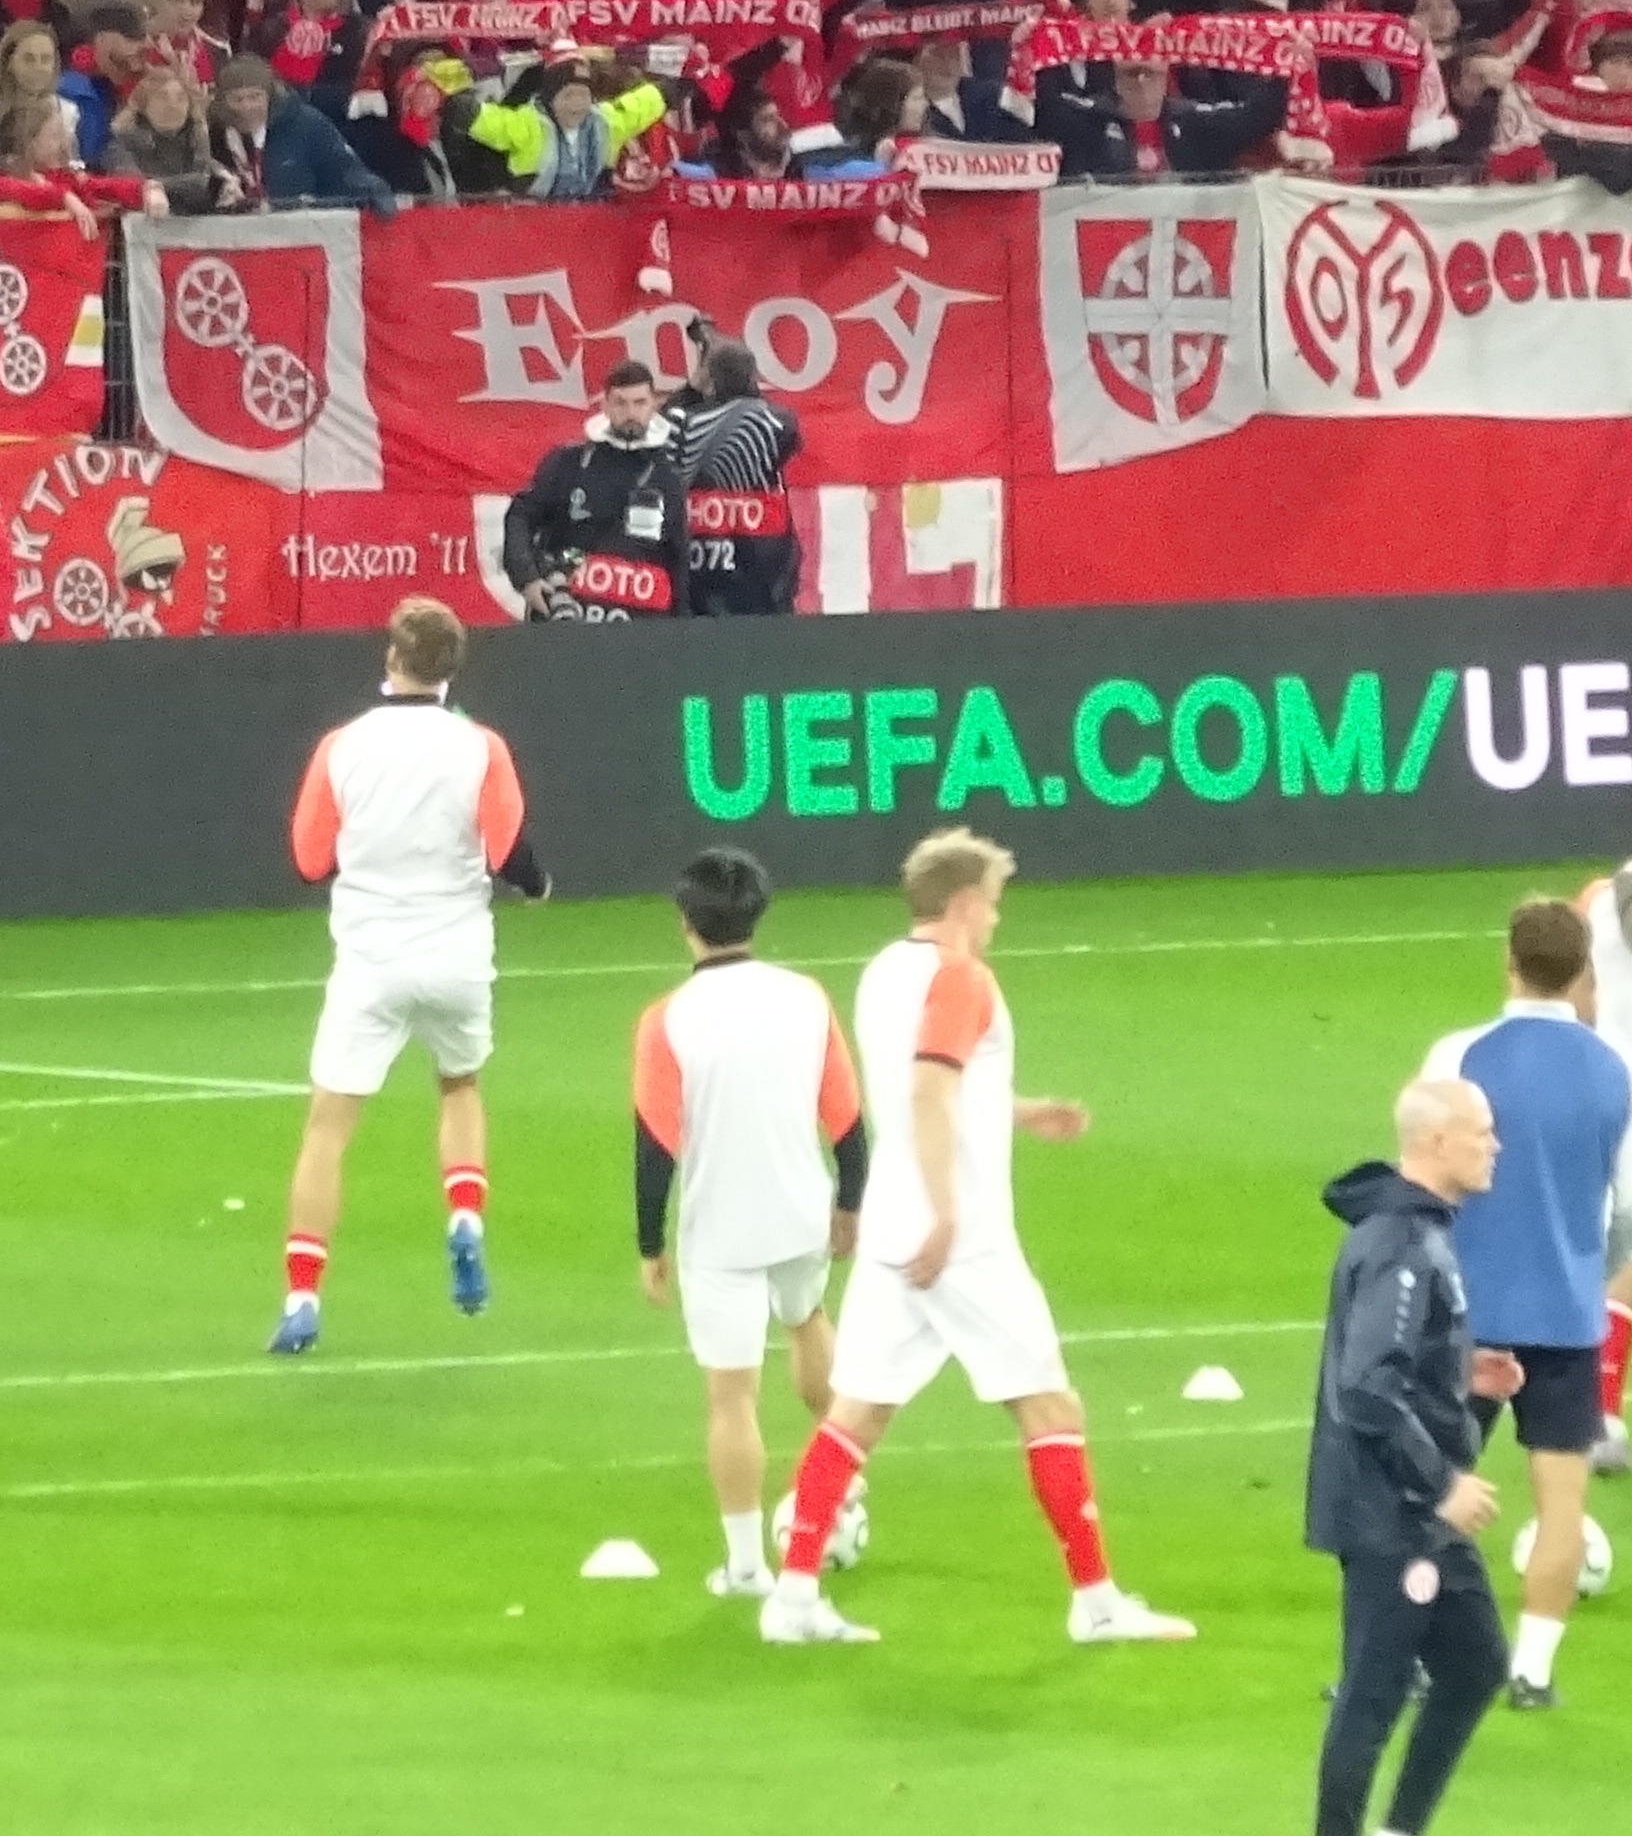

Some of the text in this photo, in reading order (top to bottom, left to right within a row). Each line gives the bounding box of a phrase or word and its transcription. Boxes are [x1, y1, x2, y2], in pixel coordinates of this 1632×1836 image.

[1078, 21, 1144, 53] FSV
[1154, 26, 1266, 64] MAINZ
[924, 153, 959, 176] FSV
[963, 151, 1031, 176] MAINZ
[746, 182, 868, 210] MAINZ
[687, 498, 765, 531] HOTO
[9, 443, 167, 643] SEKTION
[281, 533, 418, 581] Hexem
